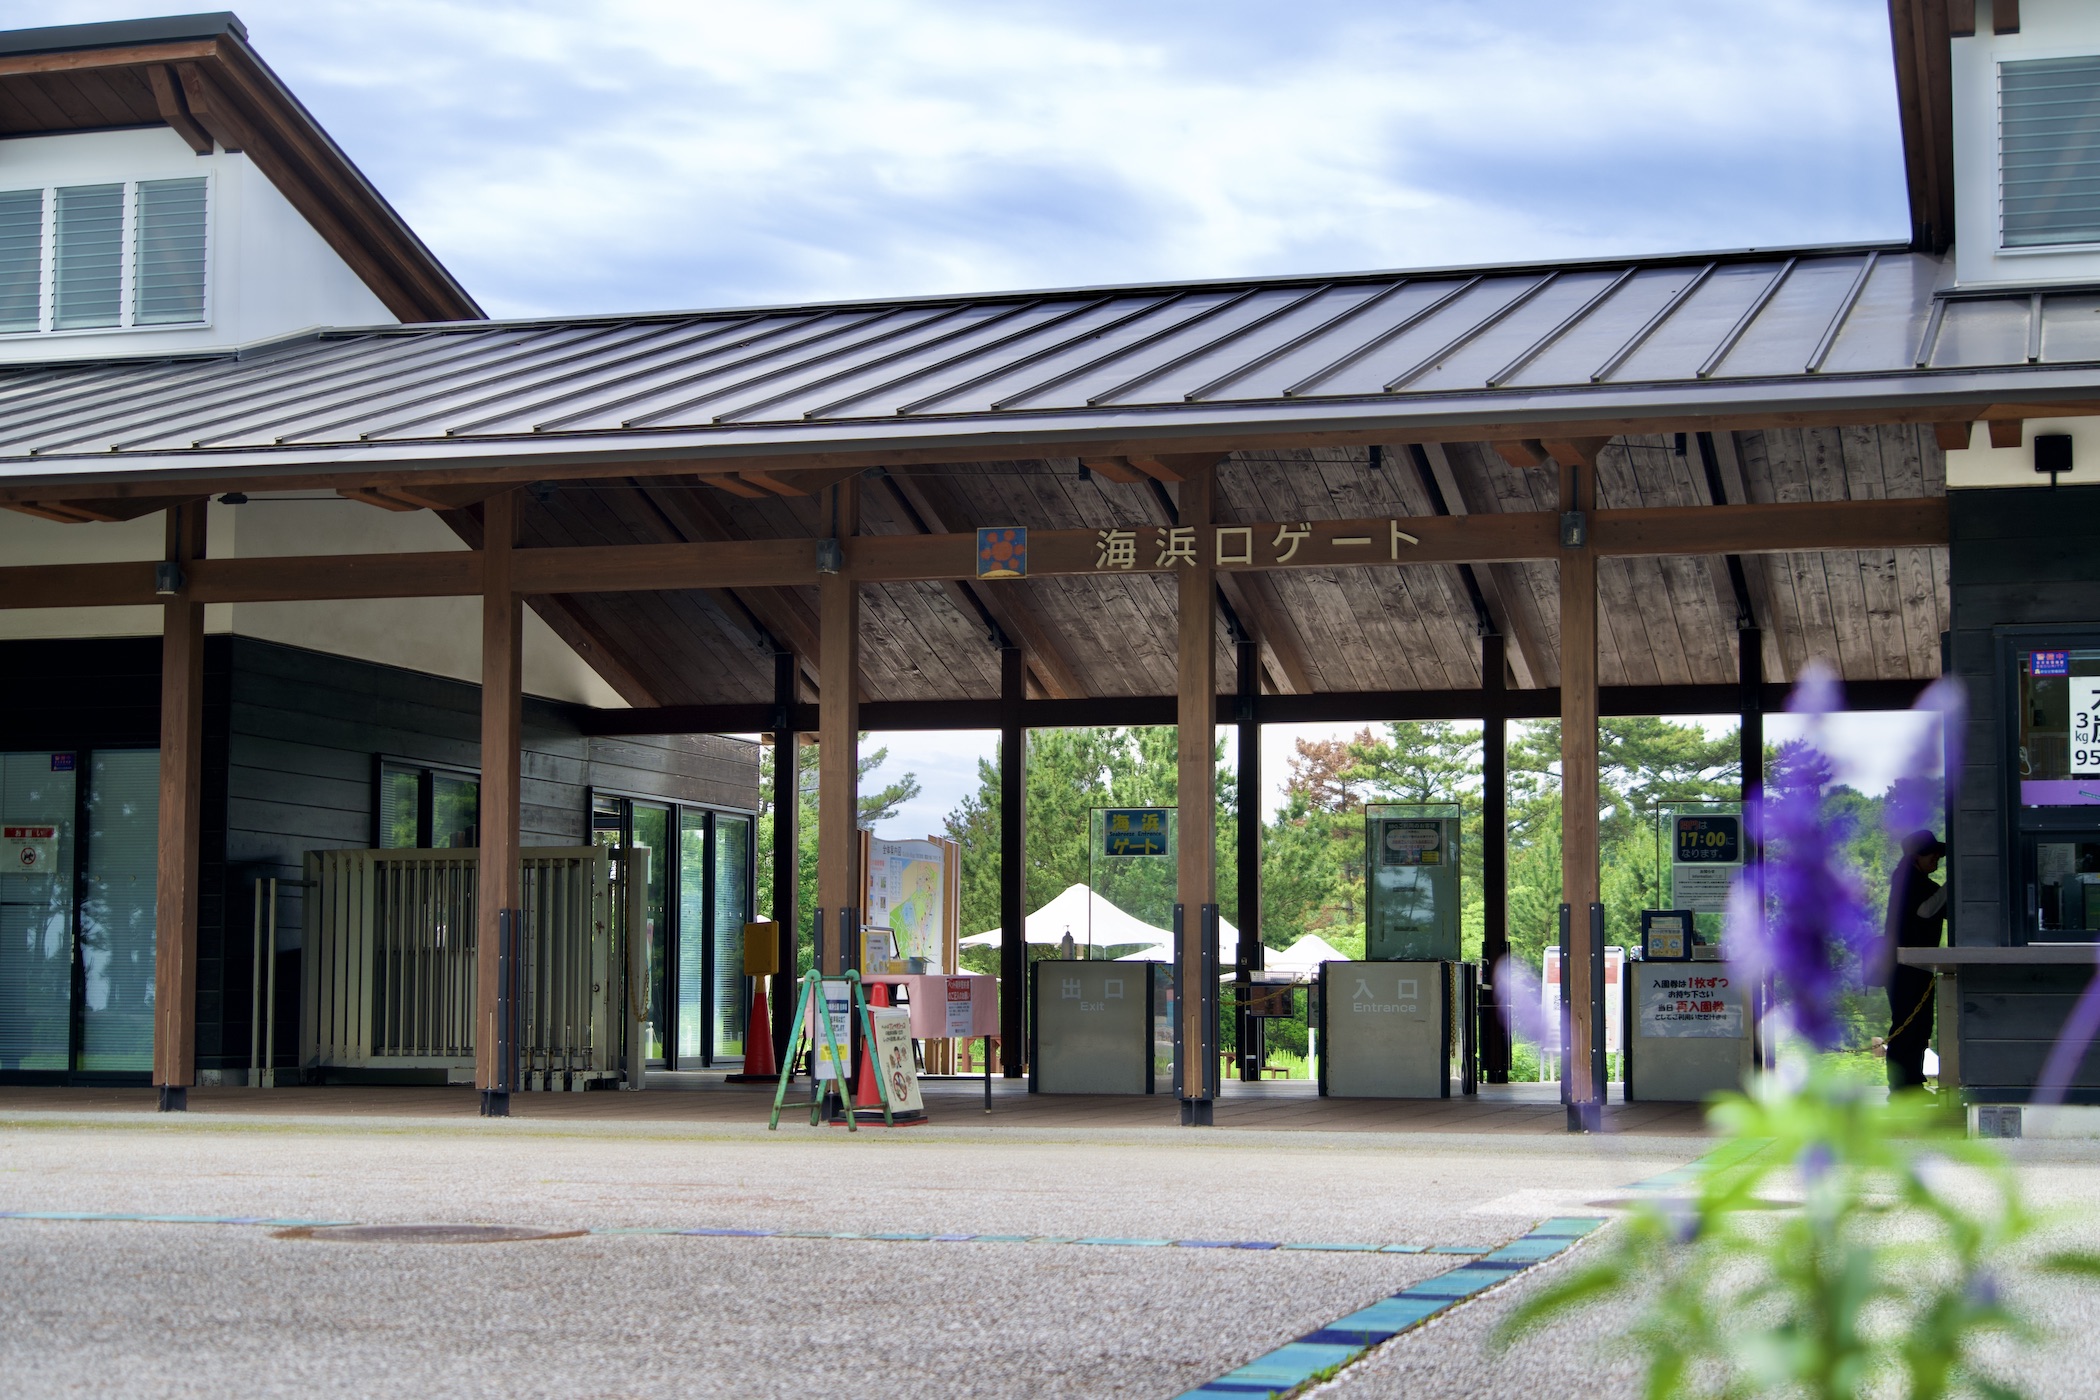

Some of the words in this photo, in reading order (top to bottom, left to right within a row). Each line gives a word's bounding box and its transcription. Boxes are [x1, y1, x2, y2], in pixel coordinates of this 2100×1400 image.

[1095, 519, 1420, 569] 海浜口ゲート
[2076, 712, 2089, 728] 3
[2075, 730, 2089, 744] kg
[1112, 813, 1160, 832] 海浜
[1113, 838, 1158, 854] ゲート
[1061, 978, 1124, 1000] 出口
[1352, 978, 1418, 1000] 入口
[1667, 990, 1714, 998] お持ち下さい
[1080, 1001, 1105, 1011] Exit
[1353, 1002, 1417, 1013] Entrance
